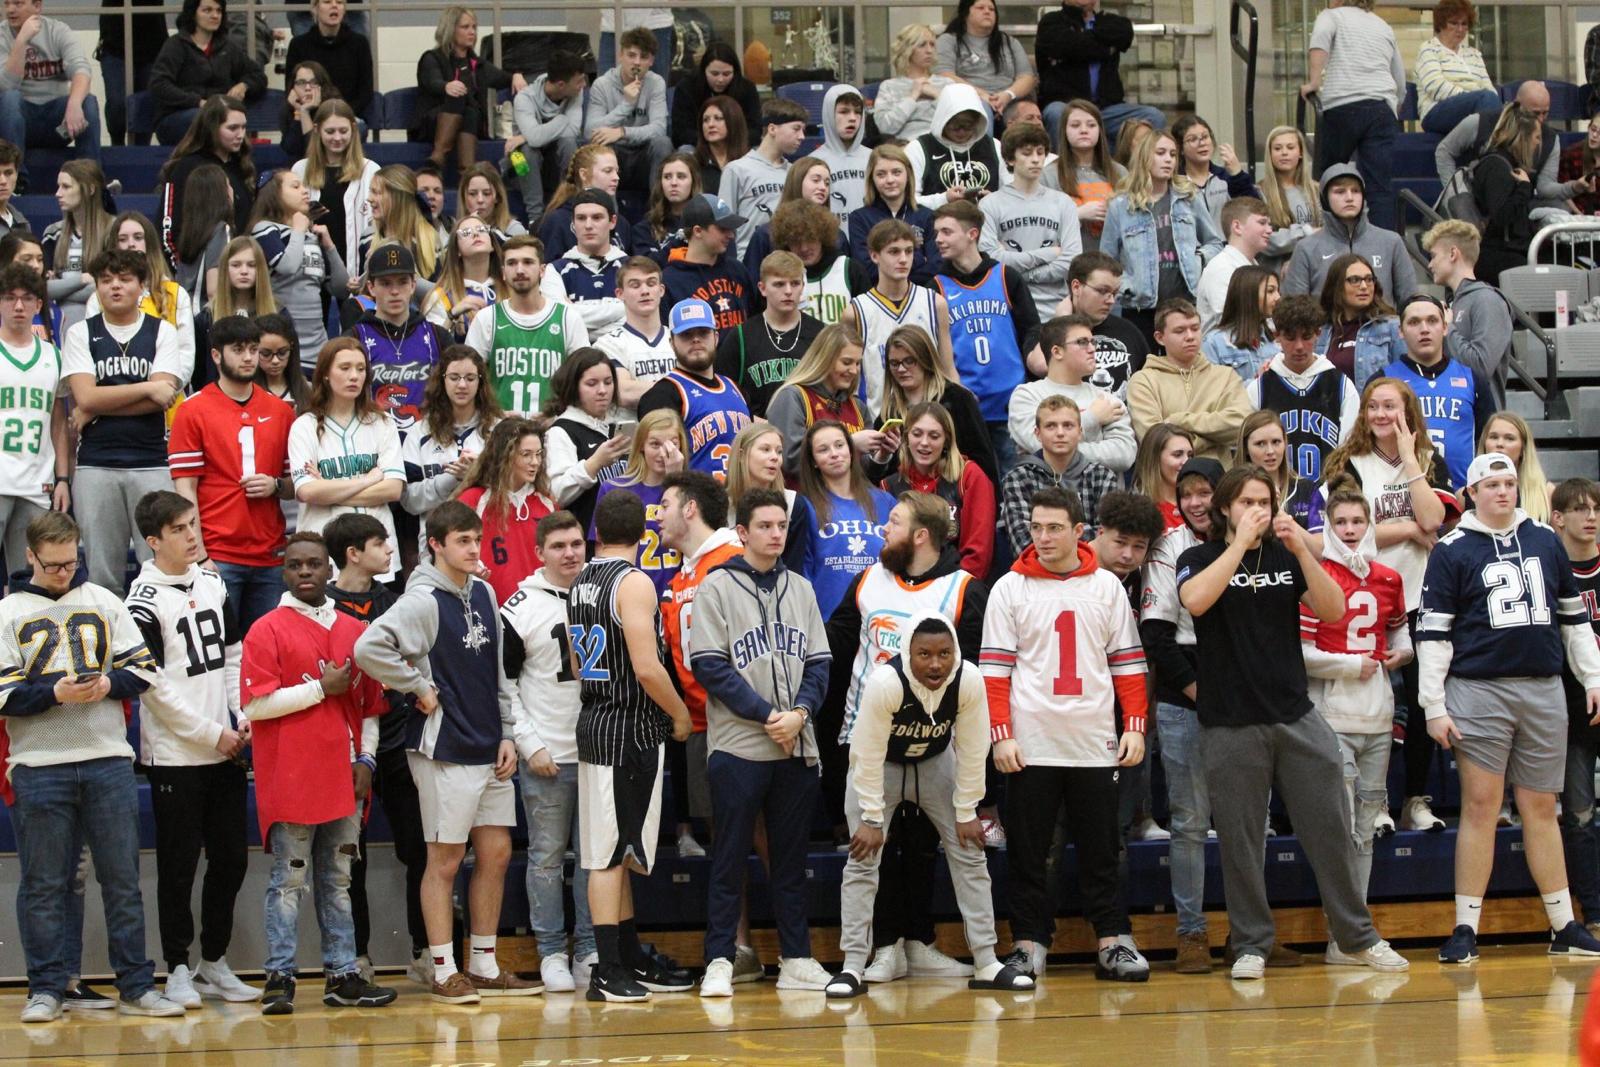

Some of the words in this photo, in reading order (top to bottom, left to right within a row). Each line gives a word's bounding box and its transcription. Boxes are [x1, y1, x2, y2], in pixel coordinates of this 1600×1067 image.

[830, 168, 865, 184] DGEWO
[1000, 215, 1060, 232] EDGEWOOD
[1372, 255, 1383, 269] E
[966, 317, 992, 334] CITY
[96, 356, 152, 381] DGEWOO
[494, 347, 562, 378] BOSTON
[974, 336, 991, 366] 0
[510, 381, 541, 417] 11
[1419, 396, 1462, 420] UKE
[3, 418, 43, 454] 23
[689, 410, 728, 454] NEW
[1280, 408, 1340, 450] UKE
[238, 426, 256, 480] 1
[491, 536, 509, 565] 6
[825, 555, 875, 566] ESTABLISHED
[1481, 556, 1552, 630] 21
[1346, 590, 1378, 651] 2
[18, 611, 110, 680] 20
[176, 608, 226, 677] 18
[550, 622, 579, 682] 1
[569, 623, 610, 681] 32
[732, 624, 771, 671] SAN
[1053, 610, 1083, 696] 1
[904, 742, 929, 758] 5
